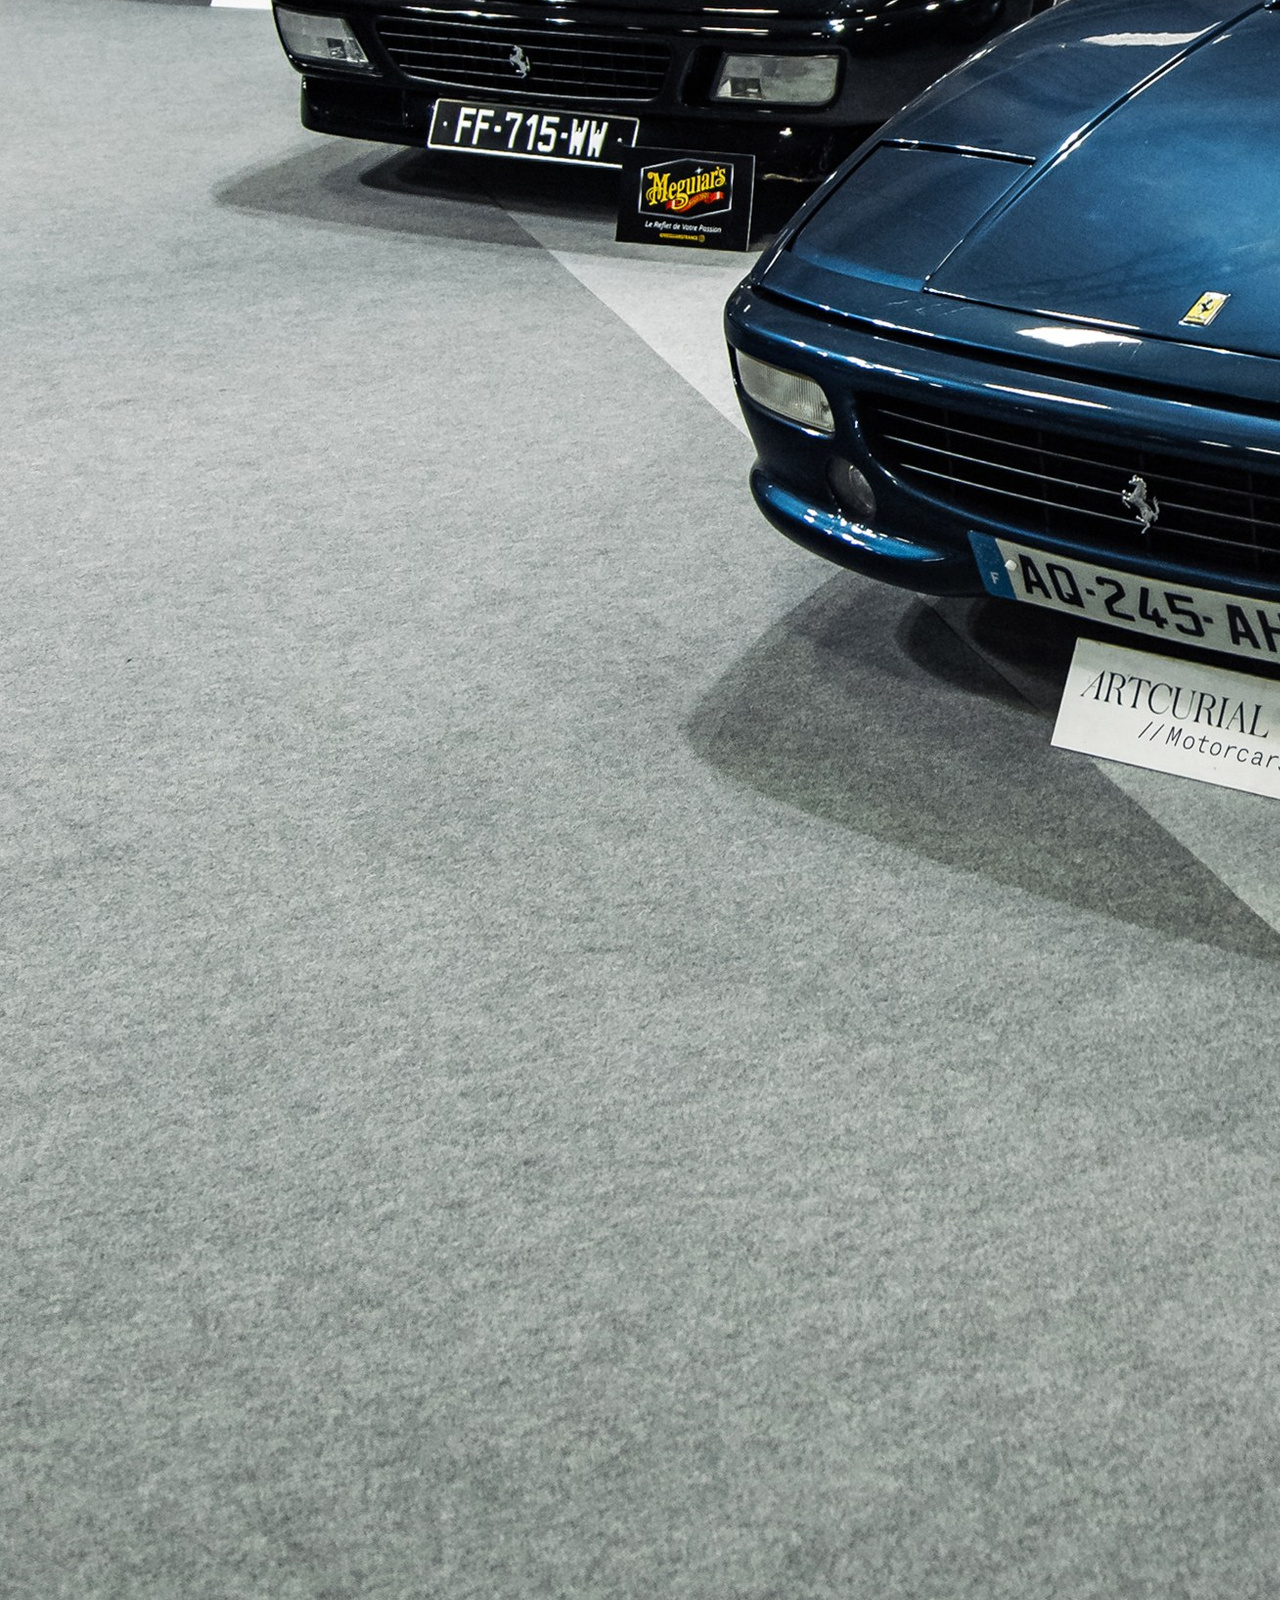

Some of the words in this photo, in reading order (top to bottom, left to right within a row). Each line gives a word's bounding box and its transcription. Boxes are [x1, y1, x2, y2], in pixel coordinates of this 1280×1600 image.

[454, 106, 609, 158] FF-715-WW
[645, 166, 726, 210] Meguiar's
[644, 220, 653, 228] Le
[698, 224, 722, 234] Passion
[990, 571, 999, 584] F
[1080, 669, 1270, 739] ARTCURIAL
